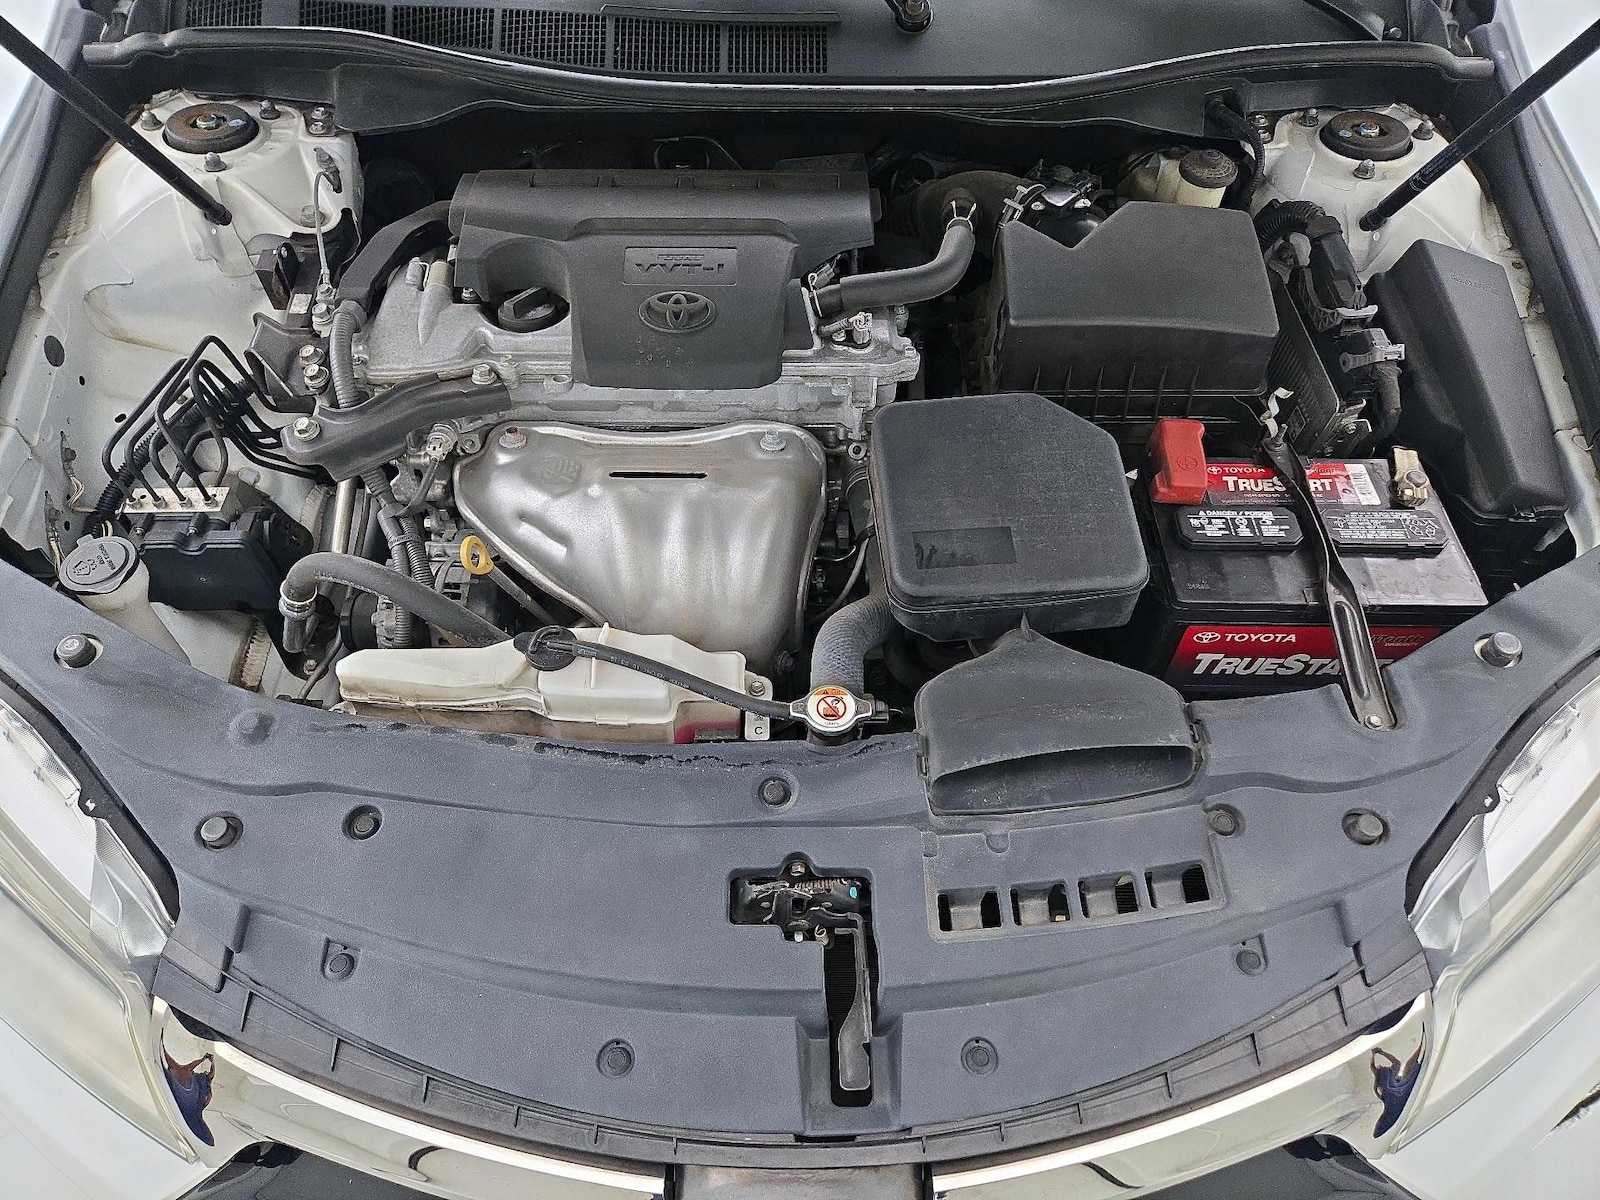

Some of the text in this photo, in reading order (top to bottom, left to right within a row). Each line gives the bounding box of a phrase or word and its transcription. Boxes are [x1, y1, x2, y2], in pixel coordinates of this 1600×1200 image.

[1222, 476, 1333, 492] TRUESRT
[1224, 633, 1297, 643] TOYOTA
[1193, 653, 1342, 675] TRUESTA
[754, 726, 763, 735] C
